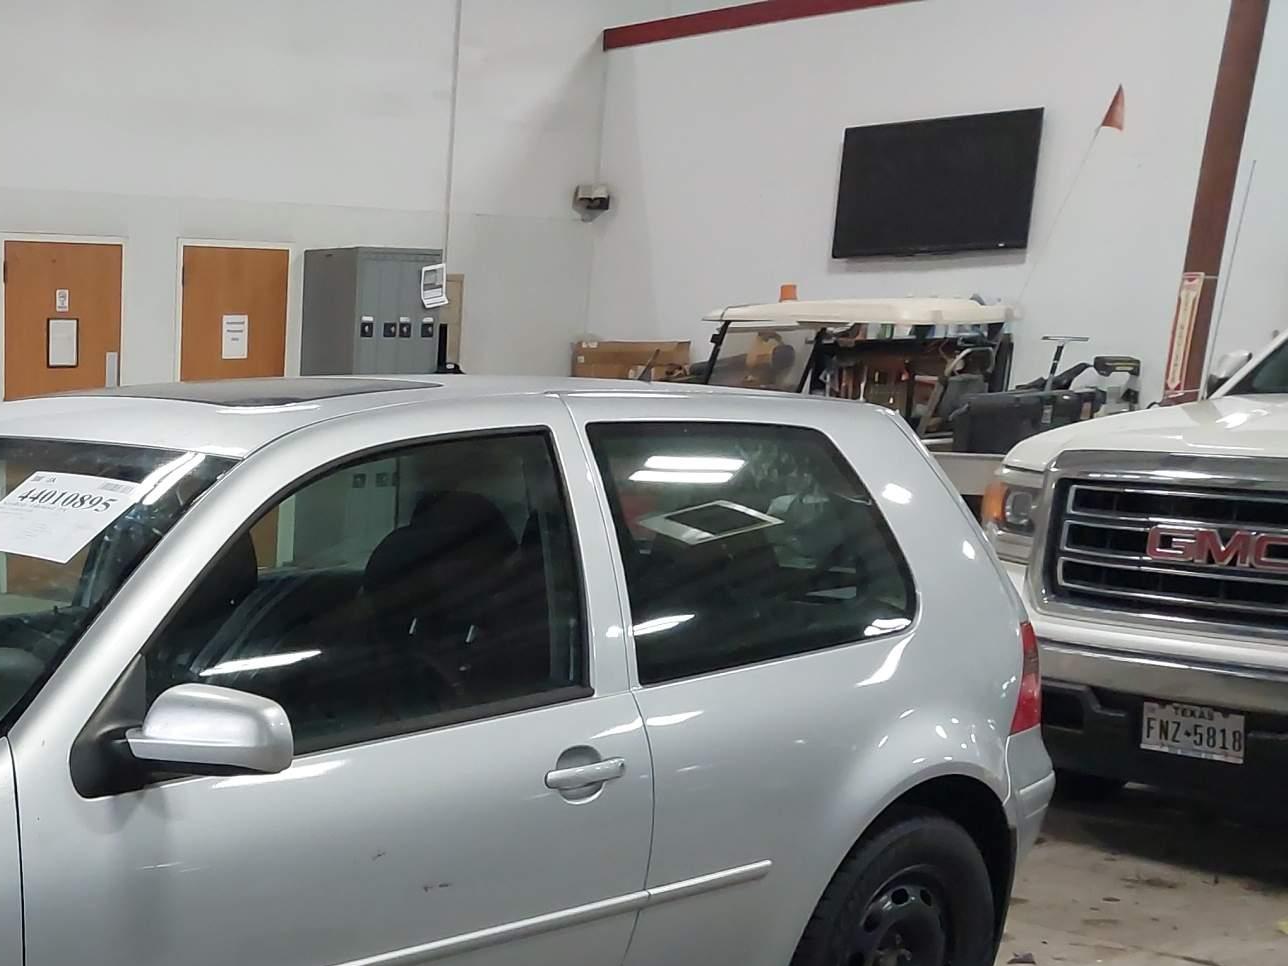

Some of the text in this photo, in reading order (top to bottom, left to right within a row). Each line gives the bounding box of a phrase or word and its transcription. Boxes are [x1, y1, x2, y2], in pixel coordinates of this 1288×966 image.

[17, 488, 117, 512] 44010895
[1146, 524, 1288, 571] GMC
[1172, 705, 1215, 721] TEXAS
